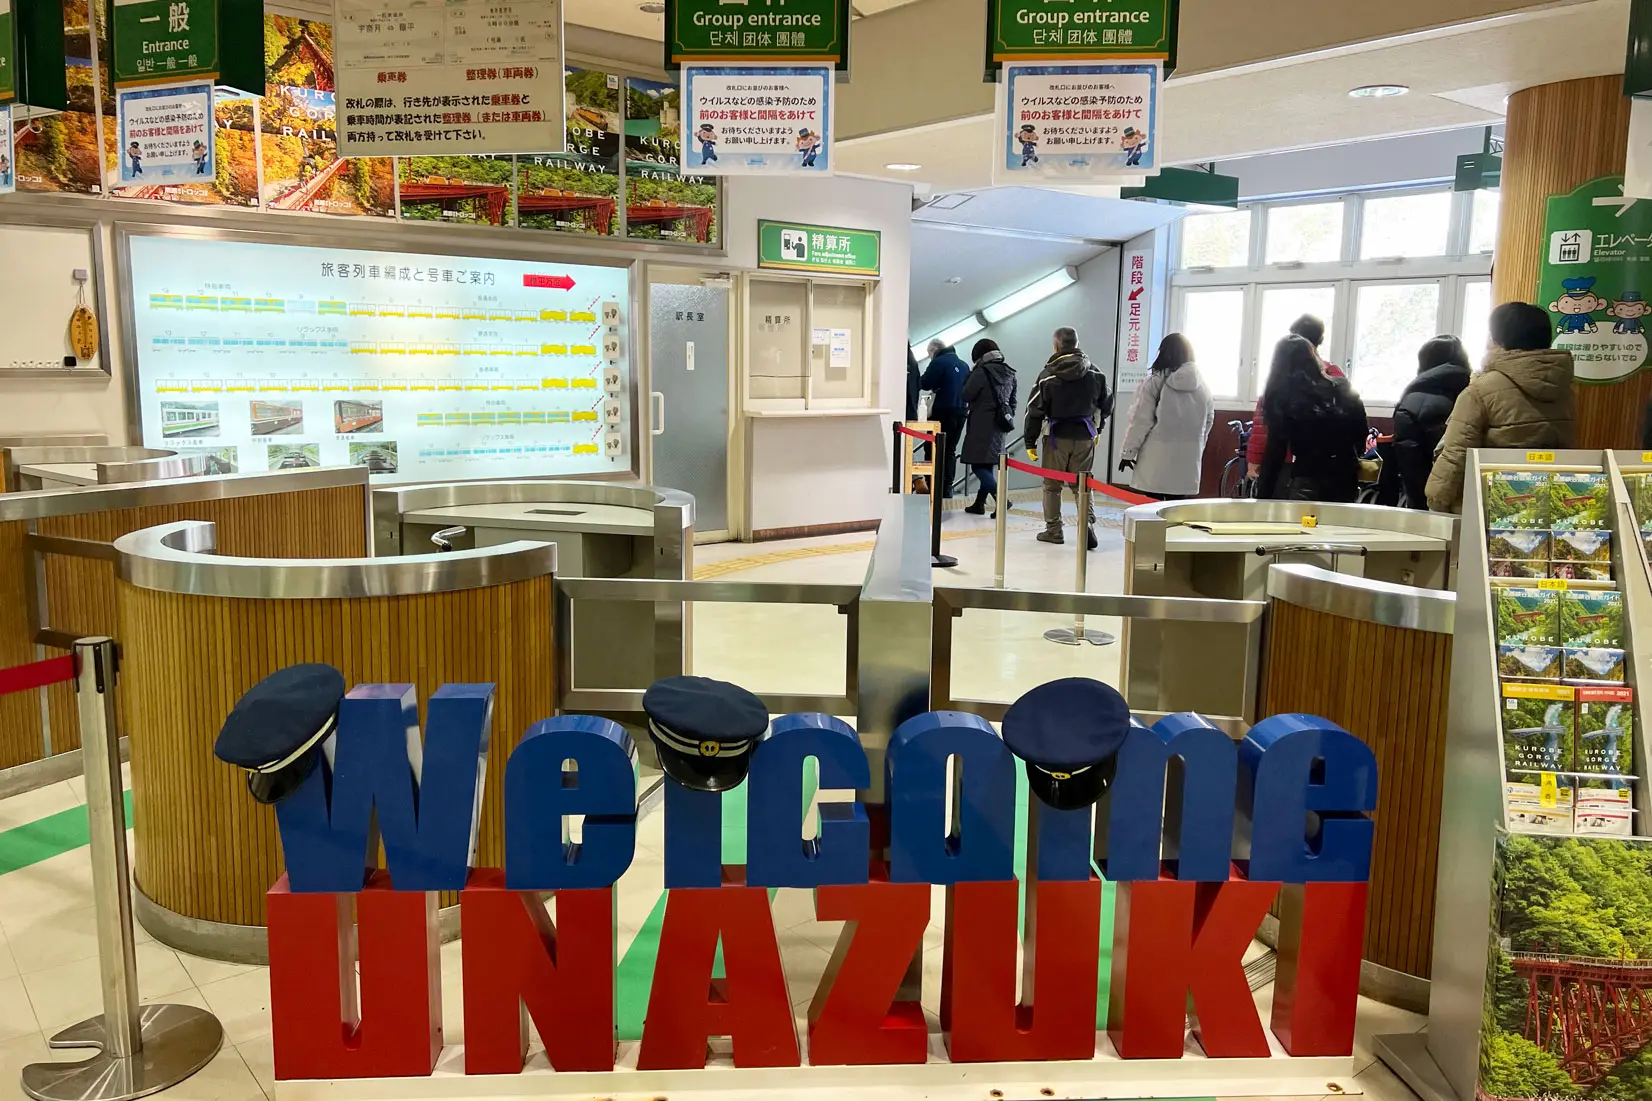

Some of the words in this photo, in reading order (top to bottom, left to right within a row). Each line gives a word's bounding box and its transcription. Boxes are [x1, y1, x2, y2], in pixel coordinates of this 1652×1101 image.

[139, 2, 190, 32] 一般
[693, 11, 744, 29] Group
[748, 12, 821, 26] entrance
[1016, 9, 1069, 27] Group
[1073, 10, 1150, 24] entrance
[710, 31, 739, 47] 단체
[743, 32, 772, 47] 团体
[1033, 28, 1063, 44] 단체
[1067, 29, 1098, 44] 团体
[142, 38, 189, 54] Entrance
[136, 60, 154, 73] 일반
[157, 57, 176, 70] 一般
[178, 54, 198, 68] 一般
[377, 71, 408, 84] 乗車券
[346, 94, 530, 109] 改札の際は、行き先が表示された乗車券と
[699, 96, 816, 106] ウイルスなどの感染予防のため
[1021, 96, 1143, 106] ウイルスなどの感染予防のため
[700, 110, 816, 120] 前のお客様と間隔をあけて
[1021, 109, 1142, 120] 前のお客様と間隔をあけて
[282, 126, 338, 141] RAIL
[347, 130, 487, 143] 両方持って改札を受けて下さい。
[567, 127, 606, 140] OBE
[721, 126, 794, 135] お待ちくださいますよう
[1043, 126, 1118, 135] お待ちくださいますよう
[724, 136, 791, 145] お願い申し上げます。
[1046, 136, 1115, 145] お願い申し上げます。
[534, 157, 606, 174] RAILWAY
[641, 170, 704, 184] RAILWAY
[811, 233, 851, 252] 精算所
[321, 262, 495, 286] 旅客列車編成と号車ご案内
[1131, 255, 1144, 285] 階段
[675, 312, 705, 322] 駅長室
[765, 315, 791, 324] 精算所
[1126, 302, 1141, 362] 足元注意
[1528, 453, 1554, 461] 日本語
[1540, 580, 1566, 588] 日本語
[1514, 745, 1563, 754] KUROBE
[1518, 753, 1559, 761] GORGE
[1514, 761, 1563, 769] RAILWAY
[266, 683, 1379, 893] Welcome
[266, 872, 1369, 1081] UNAZUKI
